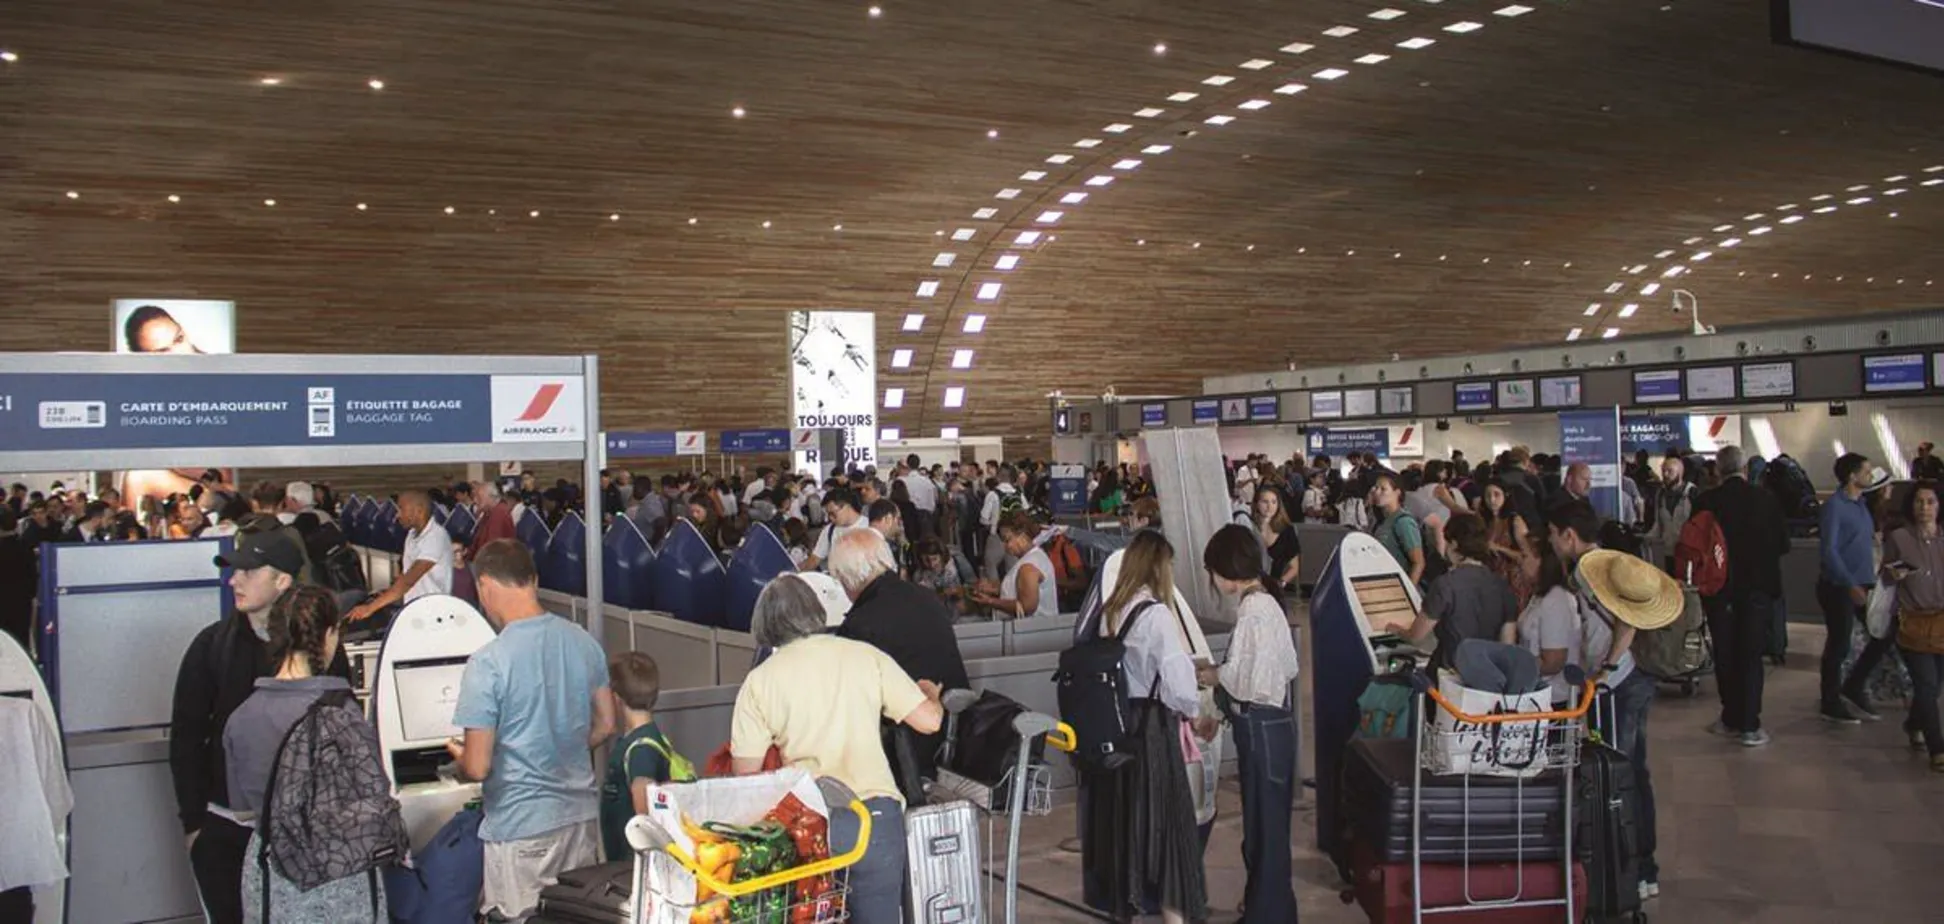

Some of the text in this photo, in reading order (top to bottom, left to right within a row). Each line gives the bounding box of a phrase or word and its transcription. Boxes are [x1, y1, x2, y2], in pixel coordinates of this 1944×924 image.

[0, 395, 12, 411] I
[120, 401, 289, 413] CARTE D'EMBARQUEMENT
[346, 400, 461, 410] ÉTIQUETTE BAGAGE
[120, 415, 228, 427] BOARDING PASS
[346, 412, 433, 423] BAGGAGE TAG
[798, 414, 873, 427] TOUJOURS
